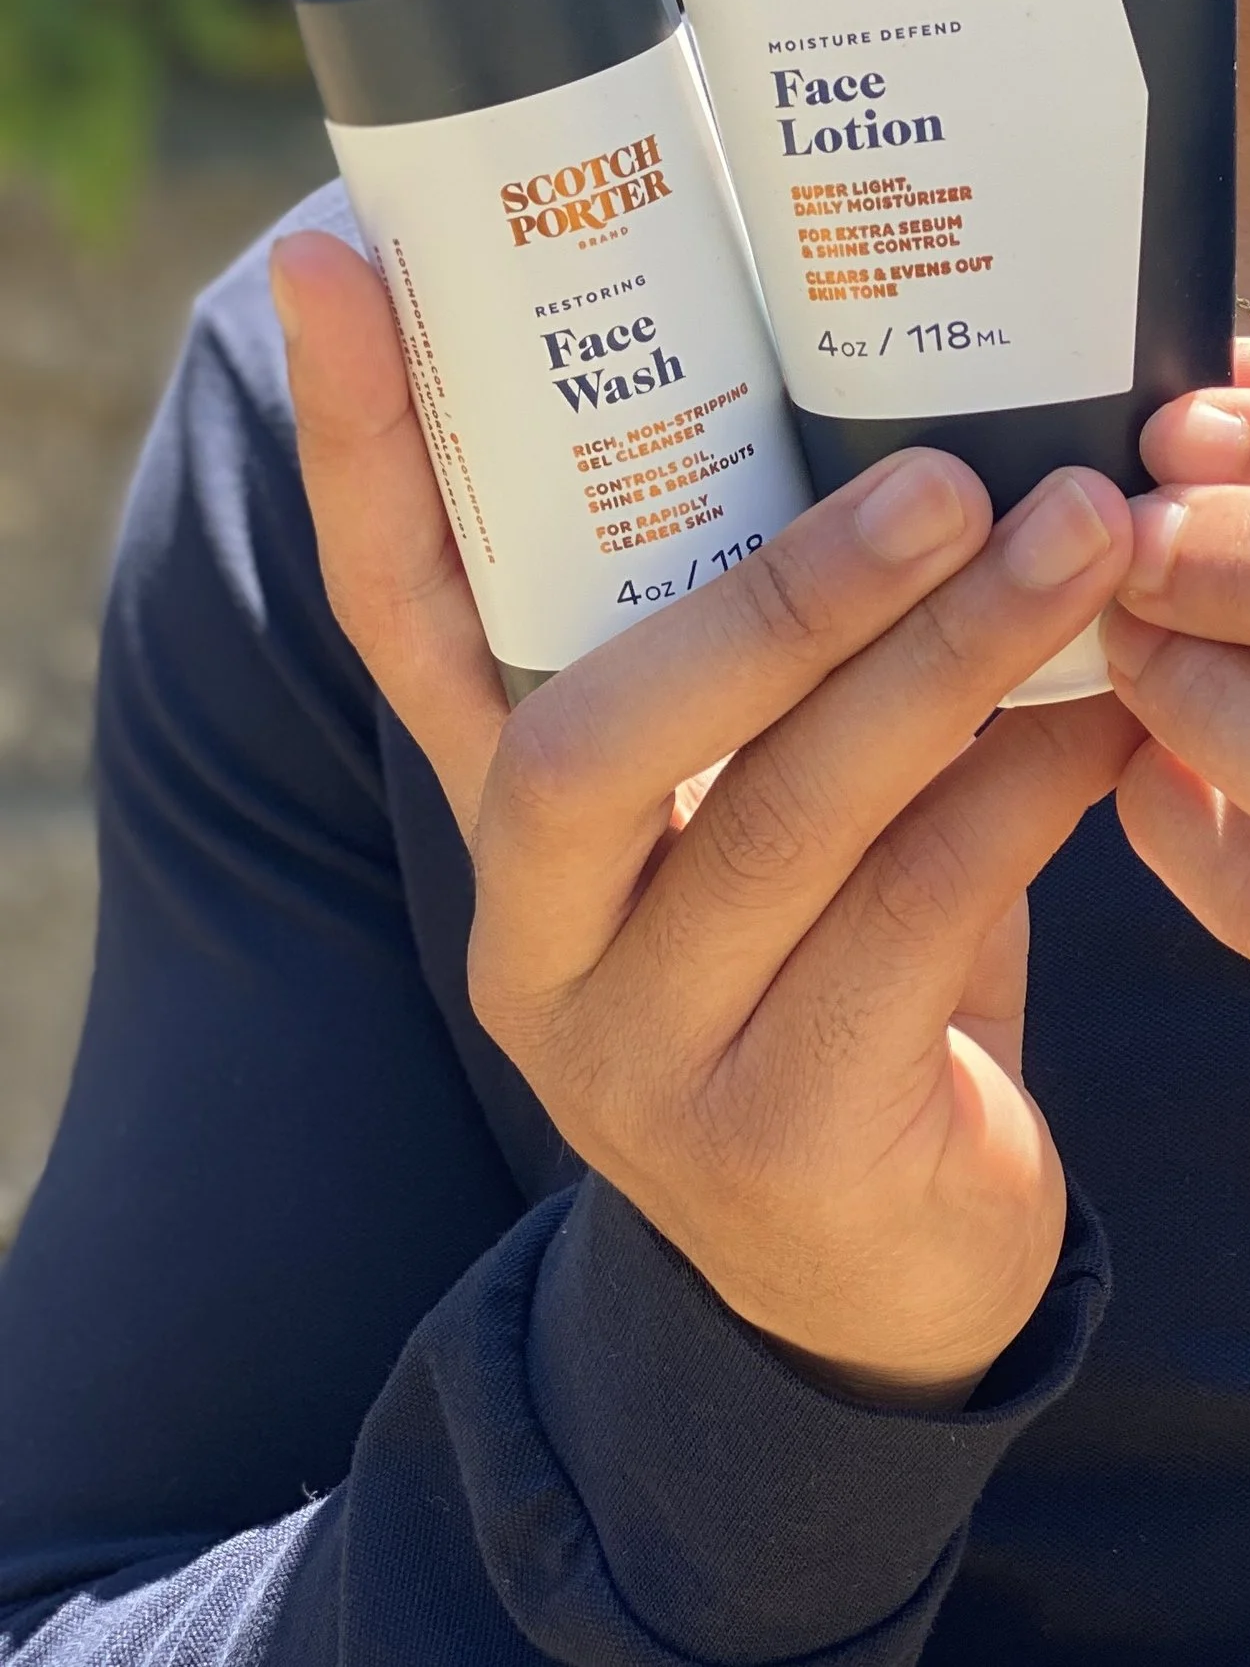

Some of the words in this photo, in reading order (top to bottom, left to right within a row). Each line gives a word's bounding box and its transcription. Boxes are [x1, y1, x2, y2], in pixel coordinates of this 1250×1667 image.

[769, 32, 871, 54] MOISTURE
[880, 21, 962, 41] DEFEND
[770, 69, 886, 108] Face
[776, 109, 945, 156] Lotion
[500, 134, 662, 214] SCOTCH
[791, 183, 848, 200] SUPER
[852, 177, 912, 196] LIGHT,
[507, 170, 673, 247] PORTER
[794, 201, 842, 216] DAILY
[847, 186, 973, 213] MOISTURIZER
[578, 226, 629, 250] BRAND
[798, 228, 832, 243] FOR
[835, 223, 894, 240] EXTRA
[898, 214, 963, 234] SEBUM
[802, 246, 813, 259] &
[817, 243, 870, 259] SHINE
[873, 233, 960, 254] CONTROL
[806, 269, 869, 285] CLEARS
[874, 268, 886, 281] &
[890, 261, 951, 280] EVENS
[955, 255, 993, 273] OUT
[535, 275, 646, 318] RESTORING
[808, 287, 847, 301] SKIN
[850, 283, 898, 300] TONE
[540, 316, 656, 370] Face
[879, 327, 893, 356] /
[552, 346, 686, 414] Wash
[573, 436, 624, 458] RICH,
[627, 382, 748, 443] NON-STRIPPING
[577, 455, 612, 472] GEL
[616, 423, 705, 462] CLEANSER
[584, 462, 678, 498] CONTROLS
[682, 450, 715, 468] OIL,
[588, 489, 645, 513] SHINE
[649, 485, 662, 497] &
[665, 444, 755, 492] BREAKOUTS
[596, 521, 632, 539] FOR
[636, 494, 708, 529] RAPIDLY
[600, 522, 681, 553] CLEARER
[685, 505, 724, 529] SKIN
[687, 559, 698, 590] /
